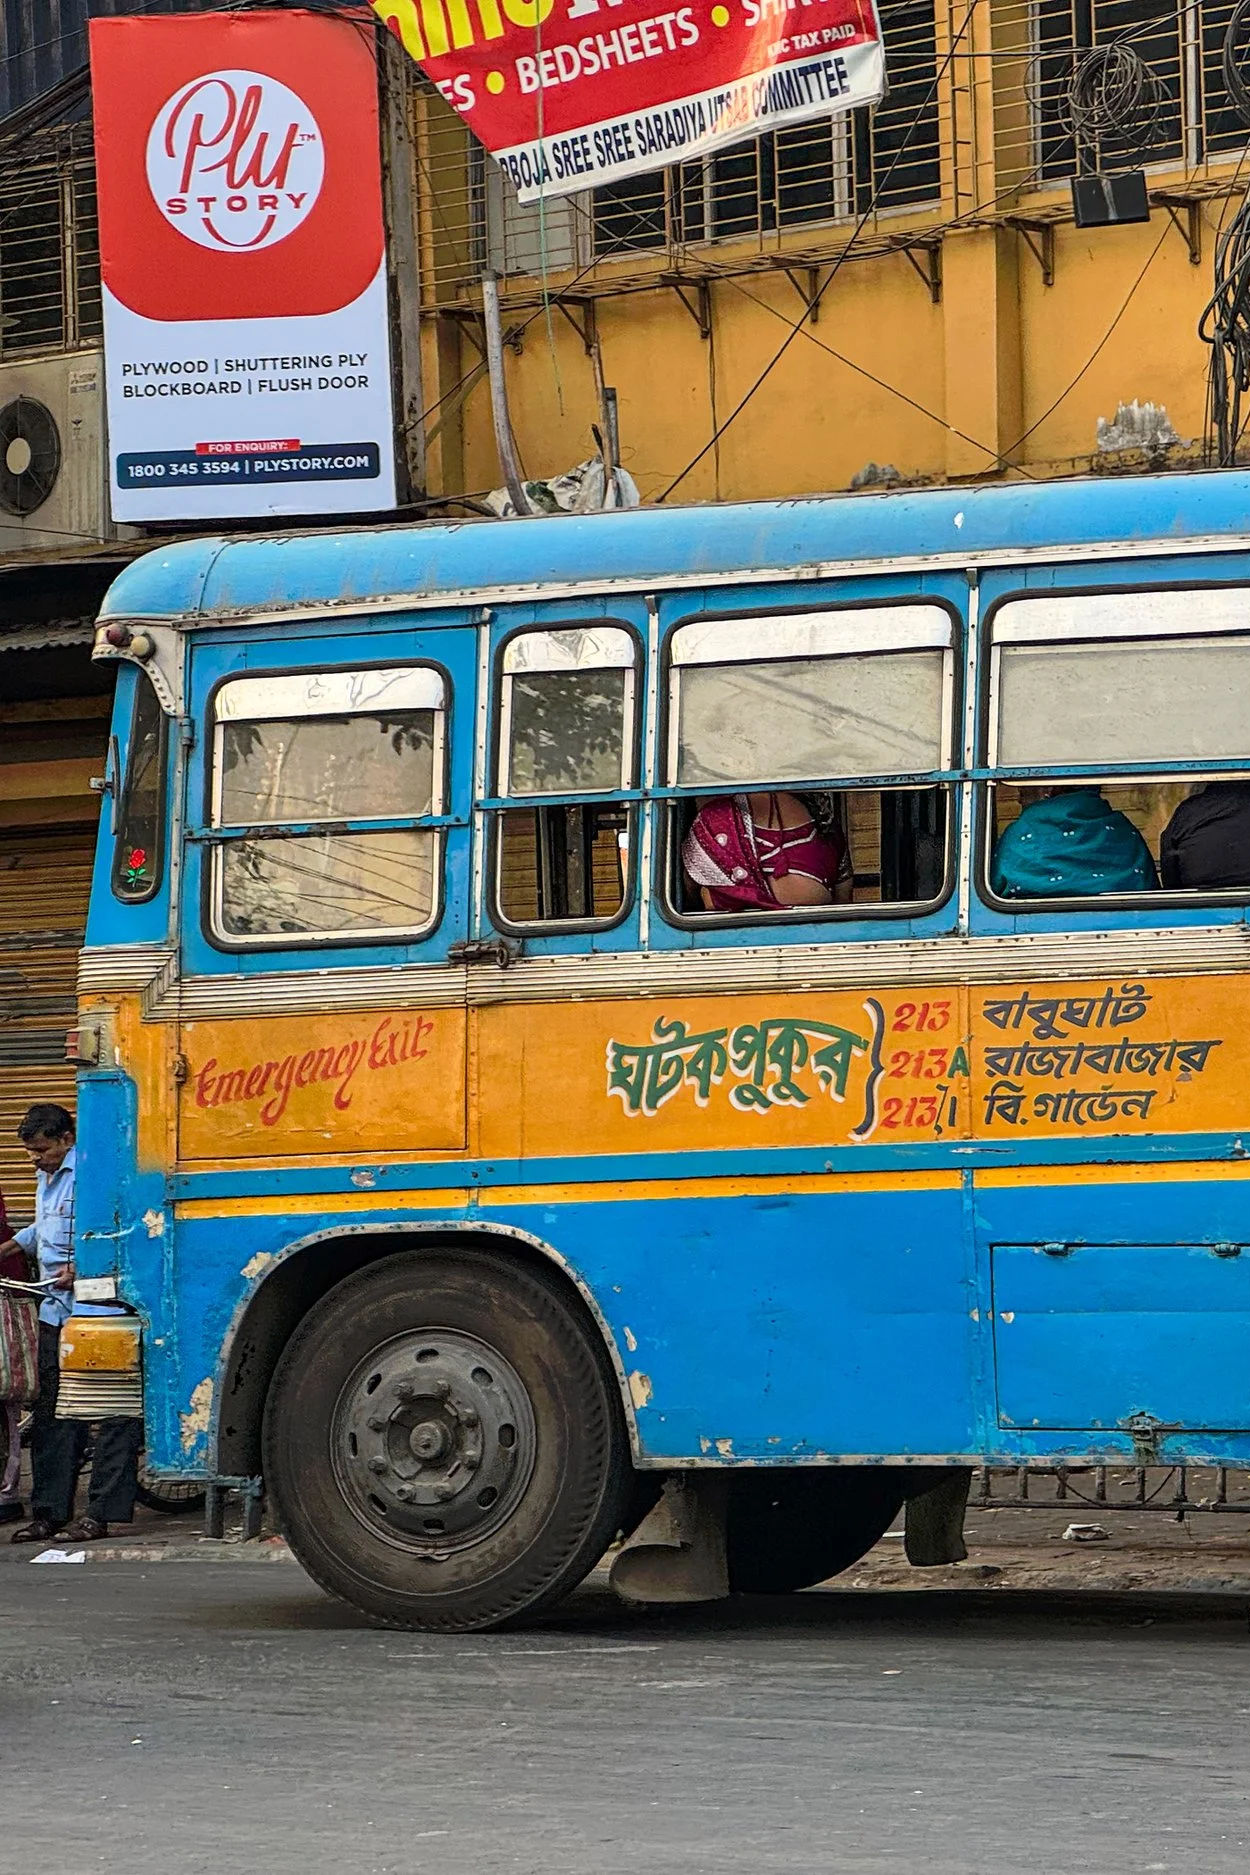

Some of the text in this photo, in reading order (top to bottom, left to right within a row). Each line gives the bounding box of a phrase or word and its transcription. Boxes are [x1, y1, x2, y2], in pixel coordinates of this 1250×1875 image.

[515, 7, 700, 94] BEDSHEETS
[790, 31, 822, 50] TAX
[821, 24, 856, 44] PAID
[552, 134, 595, 179] SREE
[593, 122, 636, 168] SREE
[634, 101, 707, 157] SARADIYA
[752, 57, 851, 118] COMMITTEE
[166, 192, 309, 215] STORY
[122, 353, 369, 377] PLYWOOD SHUTTERING PLY
[123, 375, 370, 398] BLOCKBOARD FLUSH DOOR
[208, 443, 232, 454] FOR
[128, 455, 370, 478] 1800 345 3594 PLYSTORY.COM
[891, 1001, 951, 1032] 213
[982, 983, 1154, 1040] বাবুঘাট
[193, 1016, 434, 1127] Emergency Exit
[887, 1046, 970, 1080] 213A
[984, 1037, 1223, 1079] রাজাবাজার
